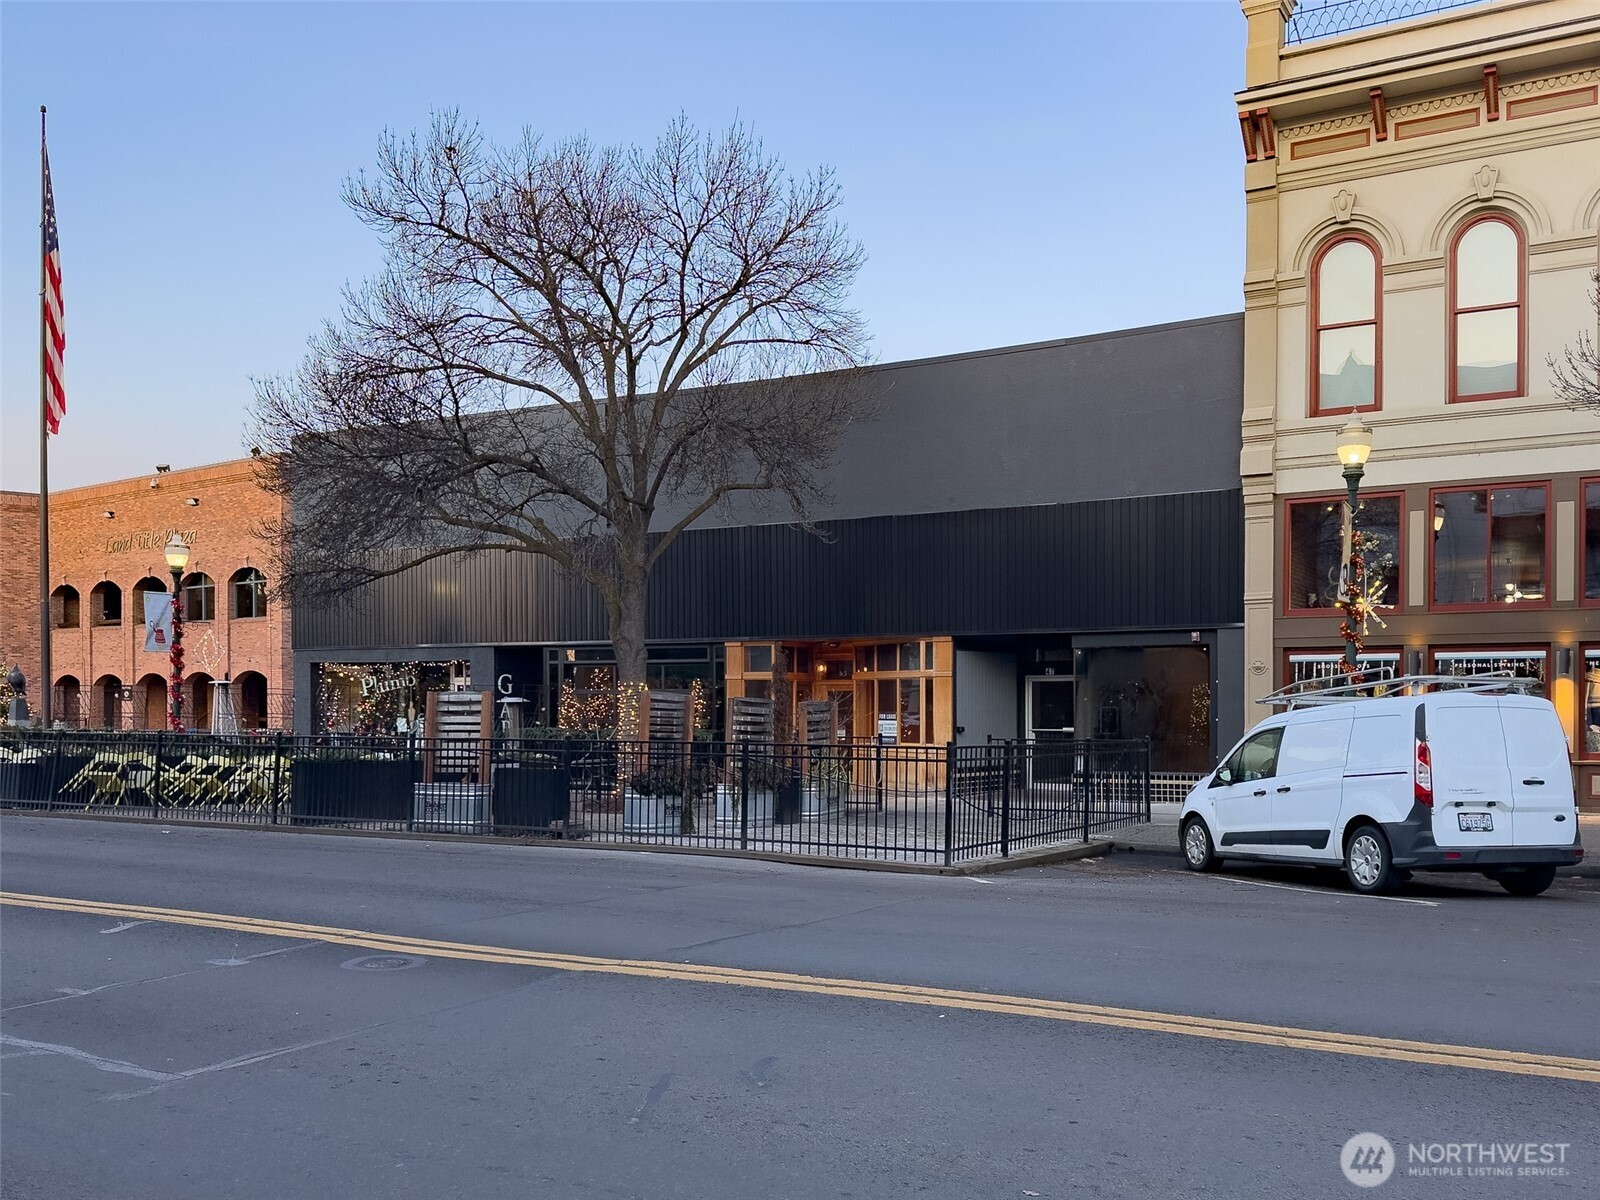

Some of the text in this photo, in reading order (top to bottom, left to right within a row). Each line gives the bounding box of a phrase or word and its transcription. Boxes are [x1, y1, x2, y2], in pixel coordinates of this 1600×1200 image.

[105, 527, 198, 554] Land Title Pza
[360, 670, 416, 697] Plumb
